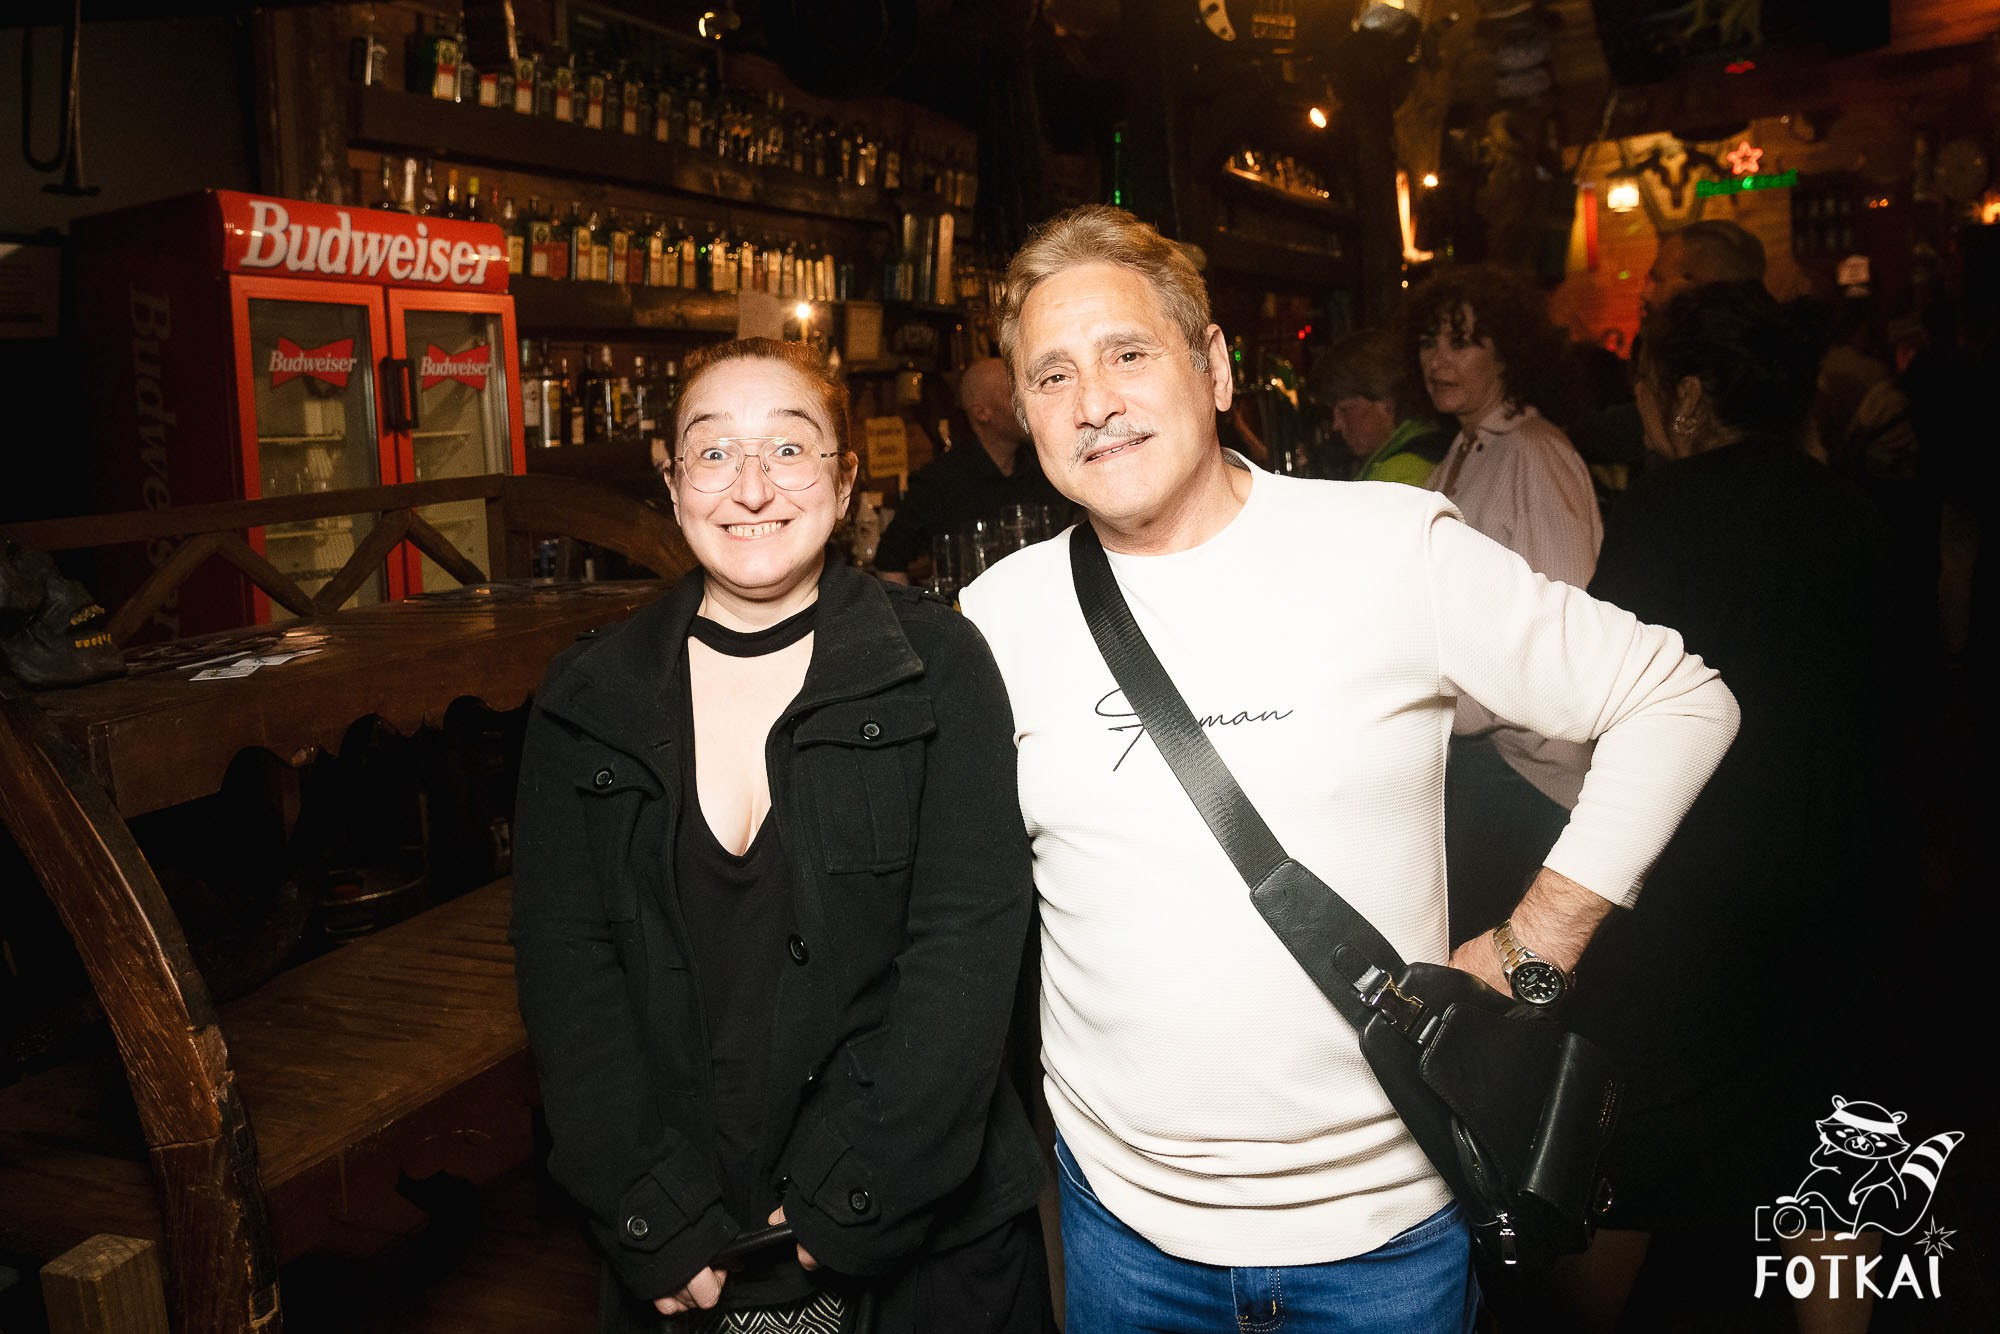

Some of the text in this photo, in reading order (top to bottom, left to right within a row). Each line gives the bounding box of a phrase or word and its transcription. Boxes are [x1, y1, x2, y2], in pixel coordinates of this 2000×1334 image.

[240, 201, 502, 285] Budweiser
[268, 350, 357, 374] Budweiser
[420, 355, 492, 377] Budweiser
[129, 280, 182, 641] Budwesr
